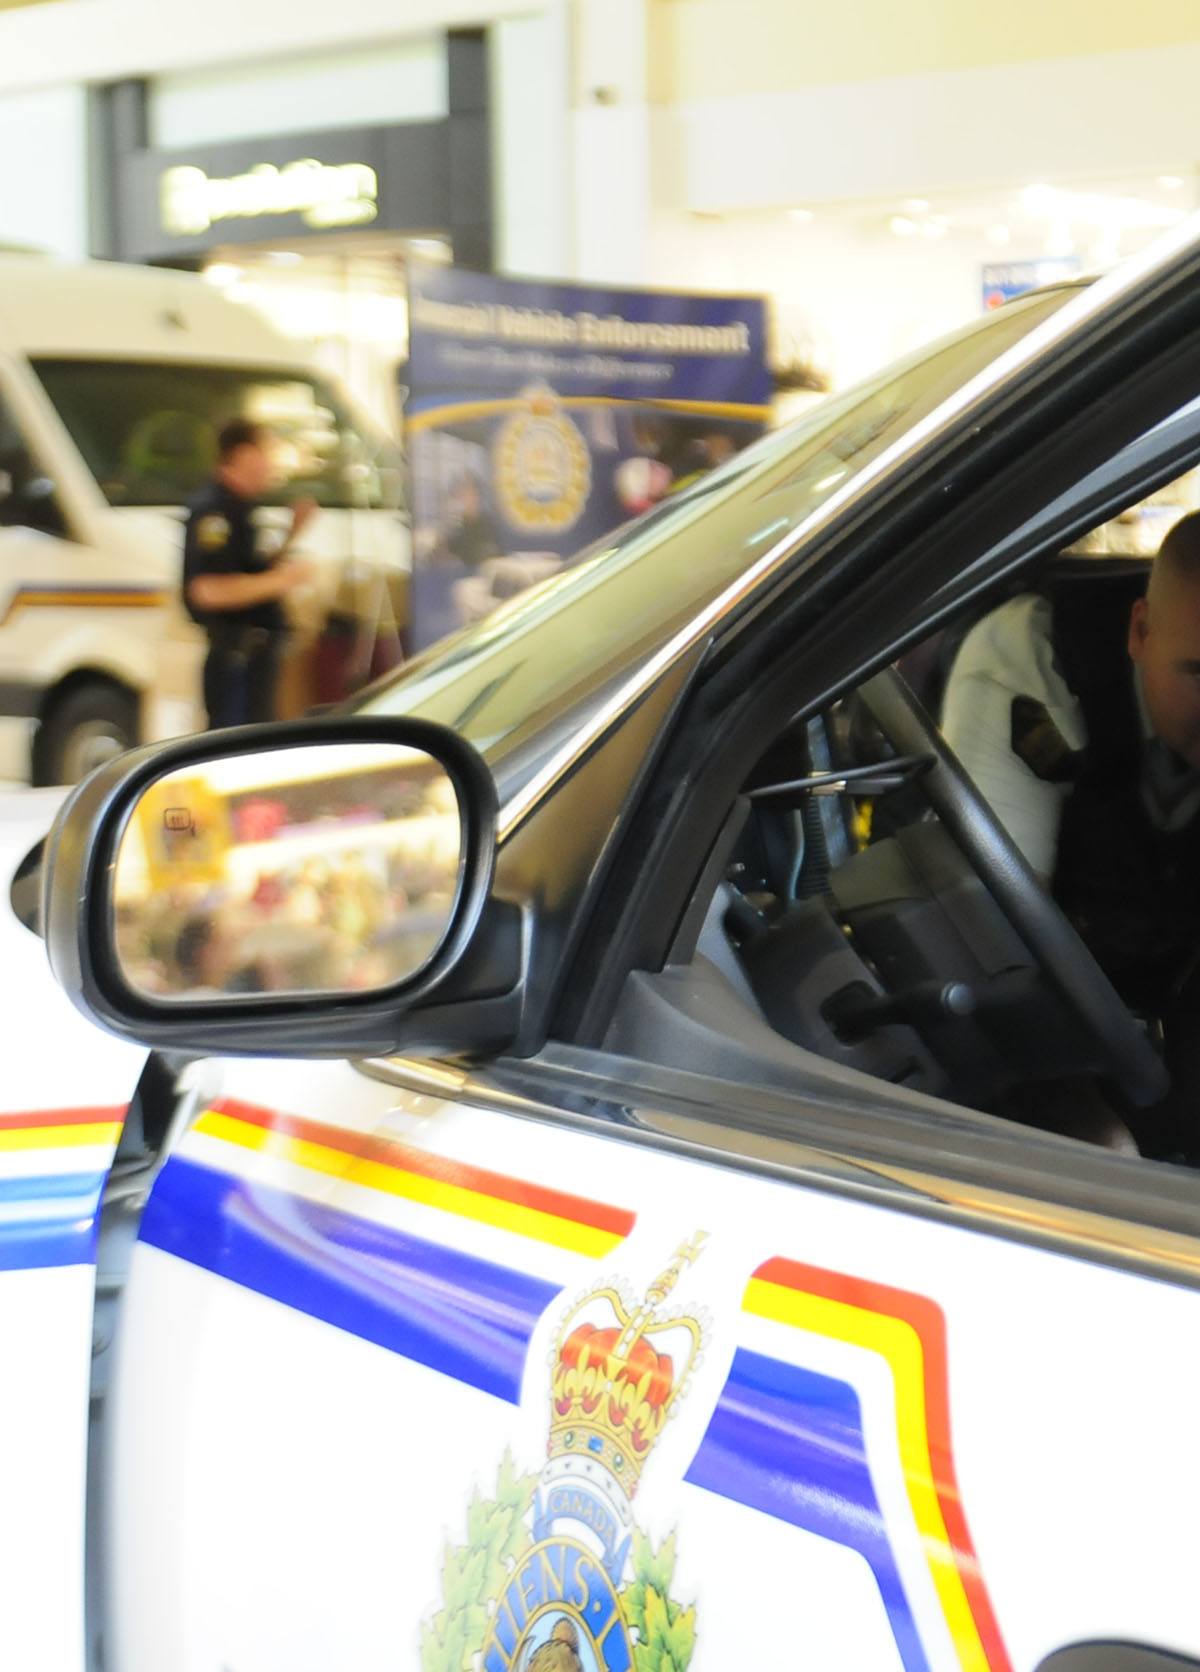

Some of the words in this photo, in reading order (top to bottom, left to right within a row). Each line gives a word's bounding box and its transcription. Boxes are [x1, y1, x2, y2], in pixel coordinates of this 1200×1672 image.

[499, 305, 575, 343] Vehicle
[577, 313, 749, 351] Enforcement
[550, 1490, 616, 1540] CANADA
